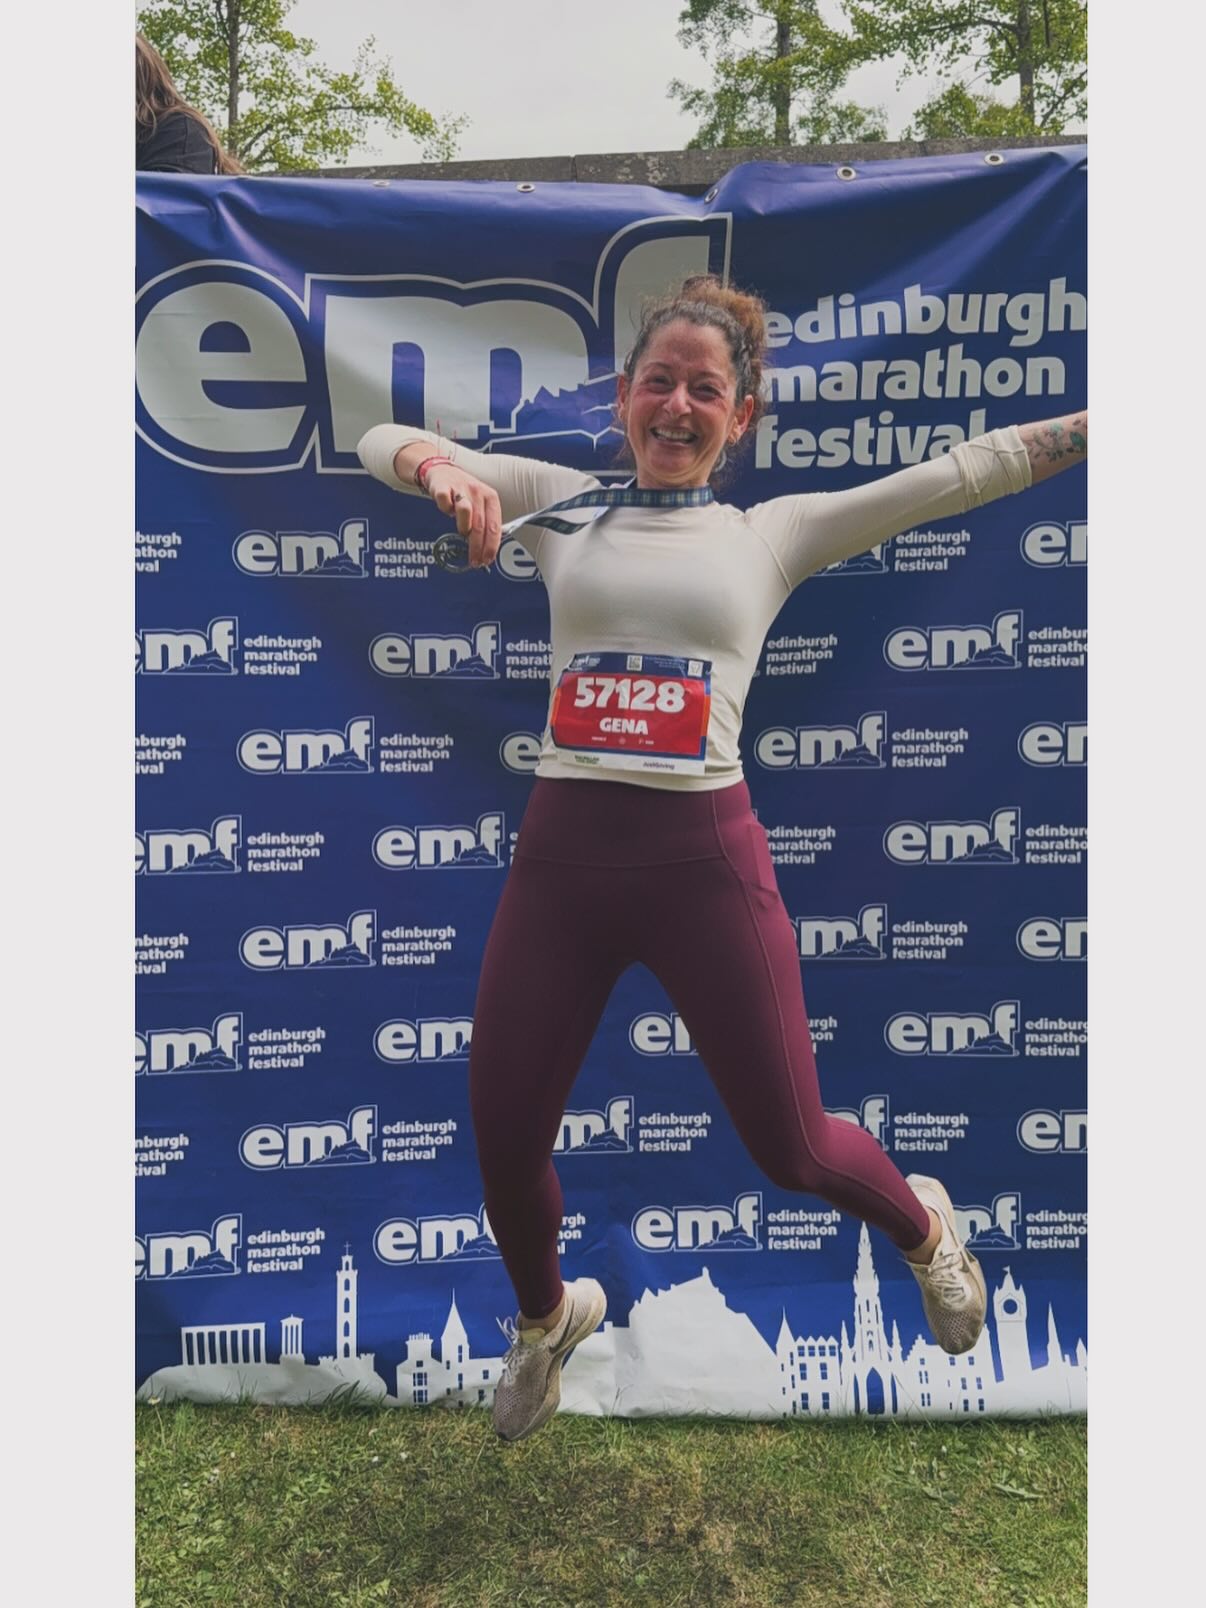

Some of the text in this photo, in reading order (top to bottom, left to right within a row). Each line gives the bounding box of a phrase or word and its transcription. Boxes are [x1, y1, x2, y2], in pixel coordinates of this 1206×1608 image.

[767, 277, 1087, 347] edinburgh
[760, 343, 1065, 402] marathon
[895, 530, 970, 545] edinburgh
[236, 522, 365, 573] emf
[895, 544, 966, 558] marathon
[374, 551, 435, 565] maratho
[895, 558, 948, 572] festival
[374, 566, 428, 578] festival
[135, 621, 234, 671] mf
[244, 636, 321, 651] edinburgh
[767, 634, 838, 649] edinburgh
[887, 614, 1019, 668] emf
[244, 649, 317, 662] marathon
[373, 625, 497, 674] emf
[766, 648, 833, 663] marathon
[1028, 653, 1084, 668] festival
[244, 662, 300, 676] festival
[766, 662, 817, 676] festival
[574, 676, 685, 713] 57128
[600, 717, 648, 735] GENA
[380, 733, 454, 748] edinburgh
[758, 715, 883, 766] emf
[892, 728, 968, 743] edinburgh
[241, 720, 370, 771] emf
[380, 747, 450, 759] marathon
[892, 741, 964, 754] marathon
[380, 760, 434, 773] festival
[892, 754, 946, 768] festival
[247, 832, 324, 847] edinburgh
[376, 816, 500, 866] emf
[887, 811, 1016, 861] emf
[135, 819, 237, 871] mf
[247, 845, 320, 858] marathon
[1025, 851, 1081, 864] festival
[247, 859, 303, 872] festival
[381, 925, 456, 940] edinburgh
[793, 907, 883, 956] mf
[892, 921, 968, 936] edinburgh
[243, 914, 372, 967] emf
[381, 939, 452, 952] marathon
[892, 934, 964, 947] marathon
[381, 953, 435, 966] festival
[892, 947, 946, 960] festival
[248, 1027, 326, 1042] edinburgh
[888, 1004, 1016, 1055] emf
[1025, 1030, 1087, 1043] maratho
[135, 1016, 239, 1072] mf
[377, 1019, 474, 1061] em
[248, 1041, 322, 1056] marathon
[1025, 1044, 1080, 1057] festival
[248, 1056, 304, 1070] festival
[382, 1119, 457, 1135] edinburgh
[553, 1100, 630, 1151] mf
[638, 1112, 711, 1127] edinburgh
[894, 1113, 969, 1127] edinburgh
[243, 1109, 373, 1167] emf
[639, 1125, 708, 1138] marathon
[894, 1125, 965, 1139] marathon
[382, 1134, 453, 1149] marathon
[639, 1139, 691, 1152] festival
[894, 1139, 948, 1152] festival
[382, 1147, 436, 1162] festival
[635, 1196, 758, 1248] emf
[768, 1209, 841, 1224] edinburgh
[247, 1228, 326, 1245] edinburgh
[768, 1223, 838, 1236] marathon
[1026, 1223, 1087, 1236] maratho
[135, 1218, 238, 1276] mf
[768, 1236, 821, 1250] festival
[1026, 1235, 1080, 1249] festival
[247, 1243, 321, 1258] marathon
[247, 1258, 303, 1273] festival
